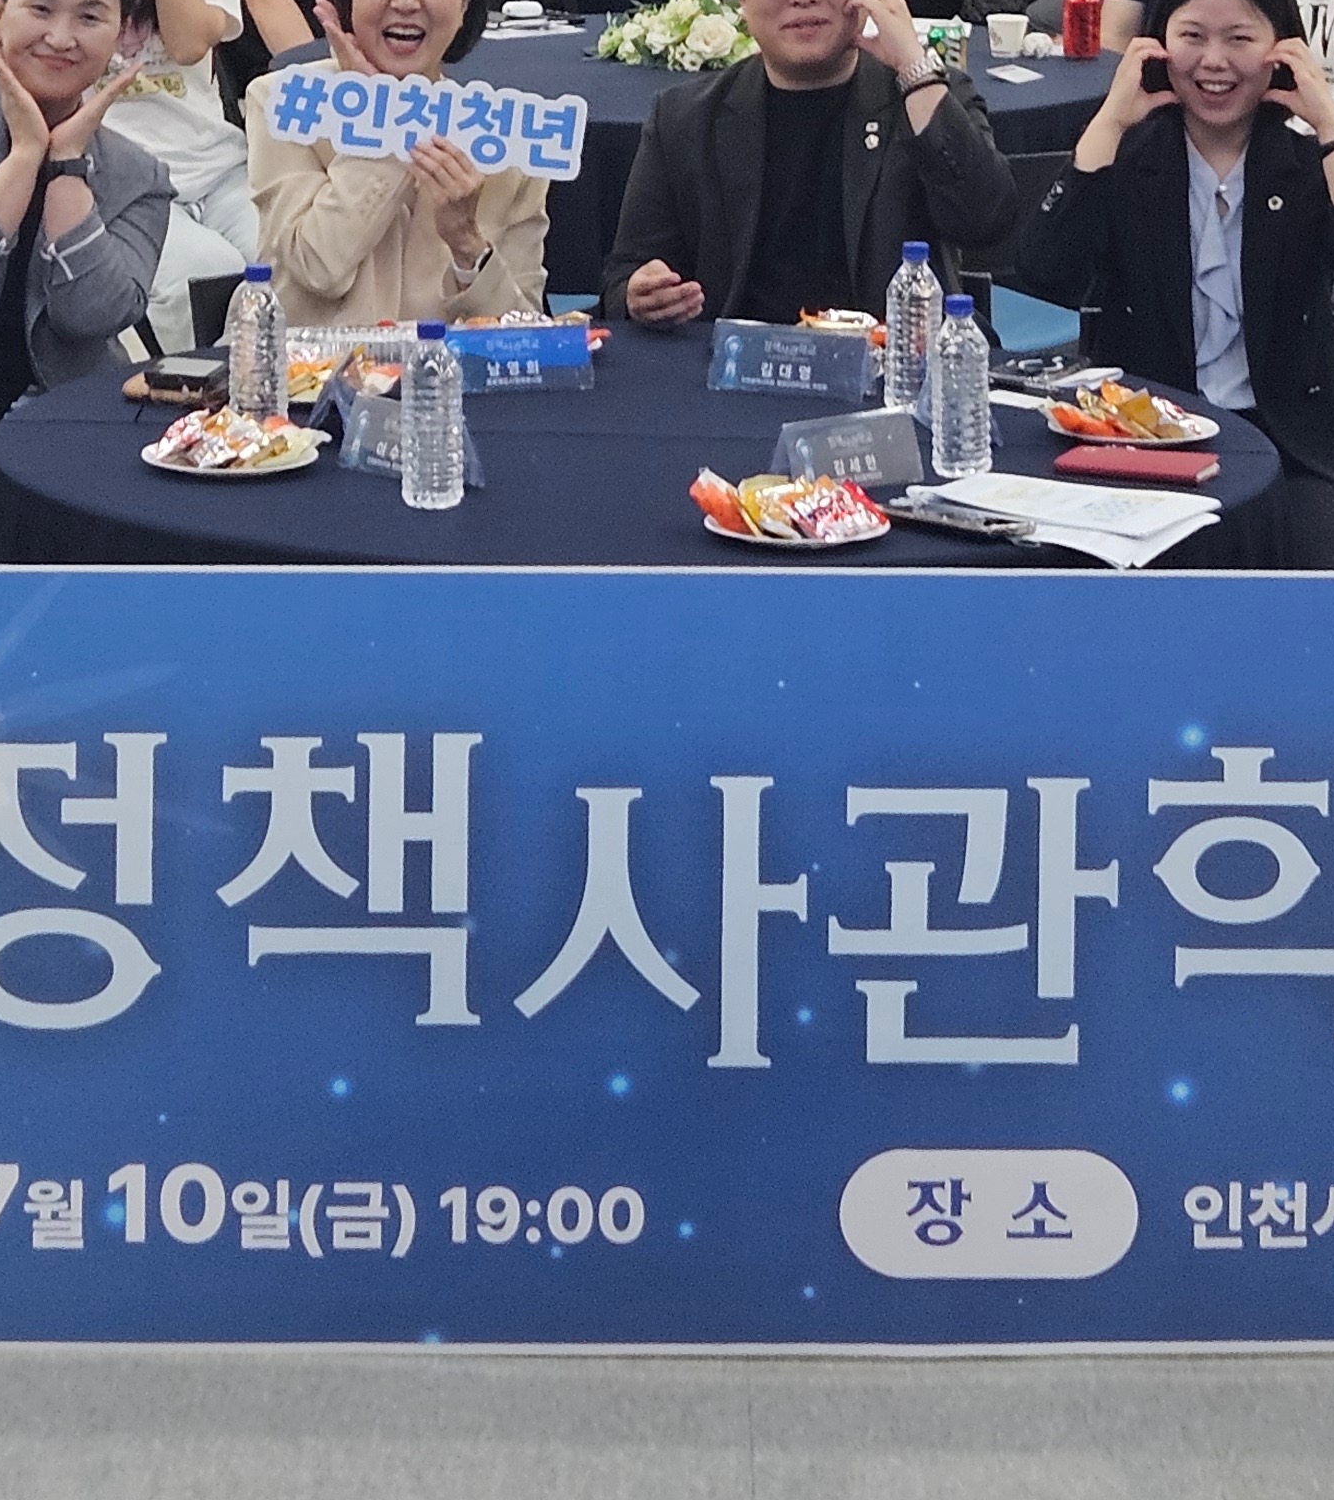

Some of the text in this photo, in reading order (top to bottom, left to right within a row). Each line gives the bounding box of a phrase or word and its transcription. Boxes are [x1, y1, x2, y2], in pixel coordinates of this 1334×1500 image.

[273, 73, 577, 170] #인천청년
[106, 1161, 417, 1258] 10일(금)
[438, 1185, 646, 1245] 19:00
